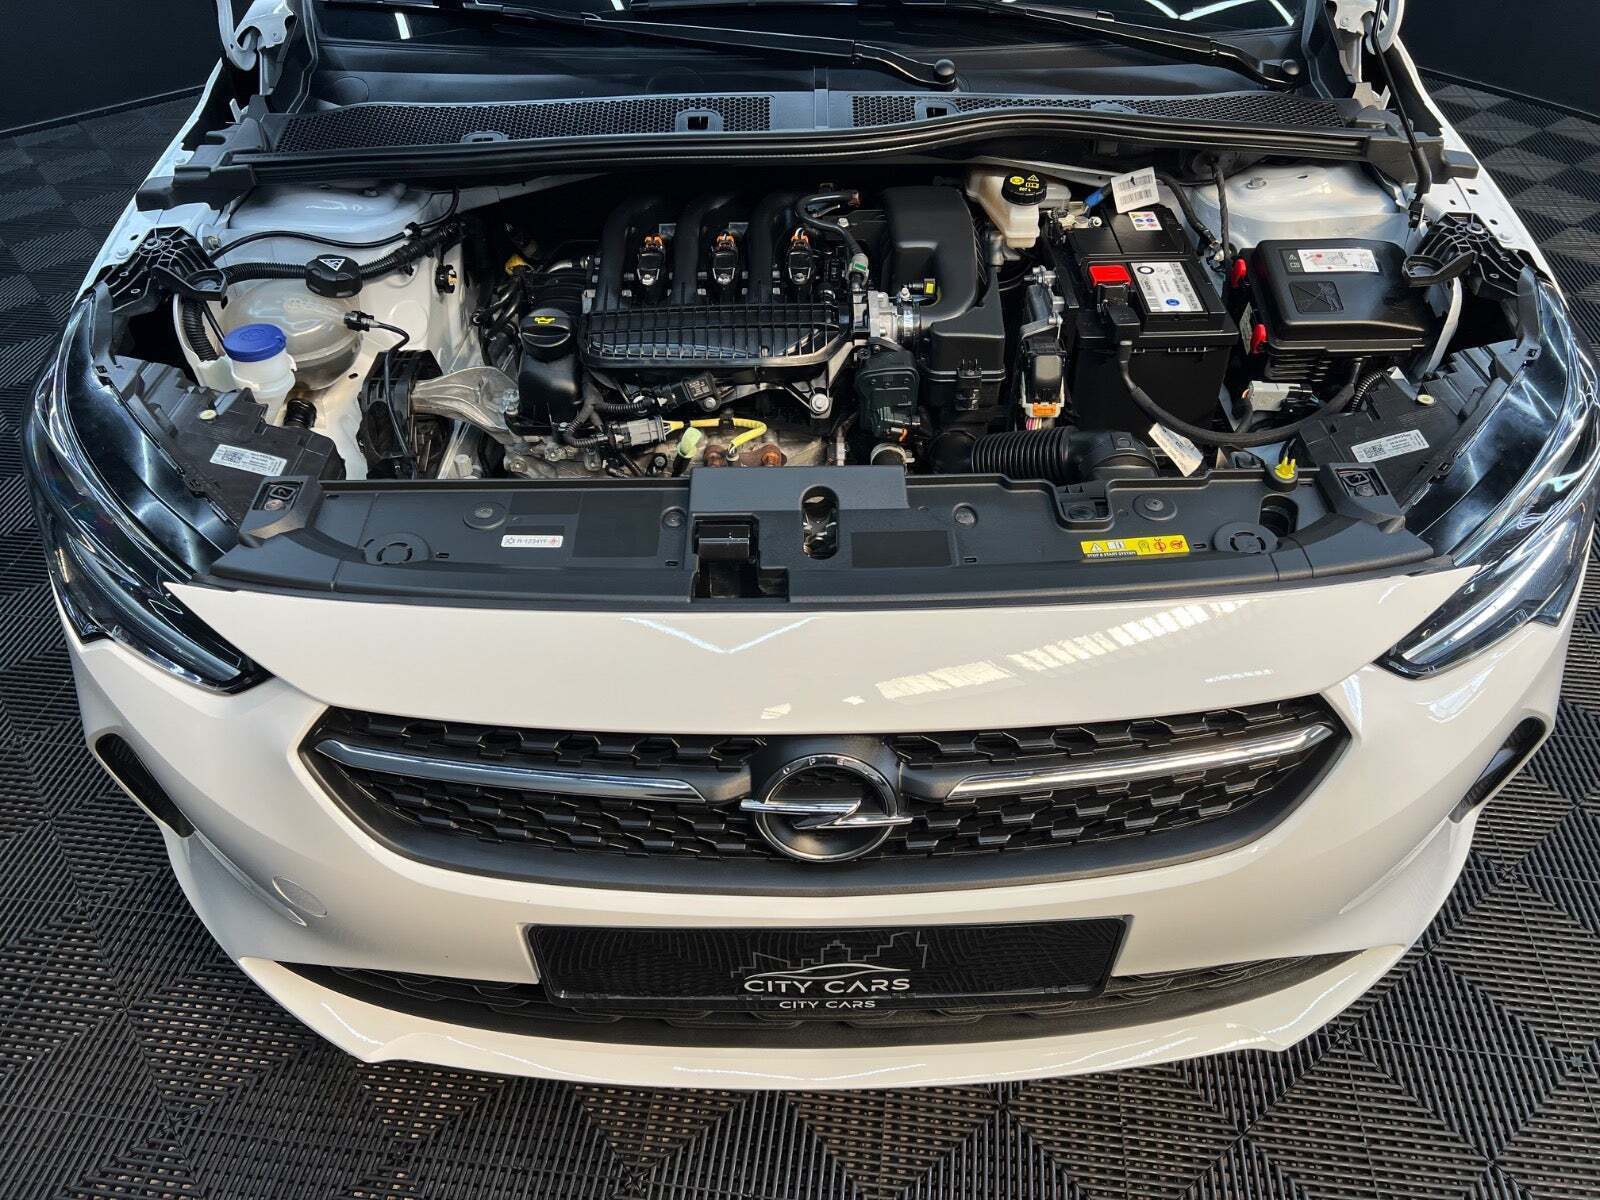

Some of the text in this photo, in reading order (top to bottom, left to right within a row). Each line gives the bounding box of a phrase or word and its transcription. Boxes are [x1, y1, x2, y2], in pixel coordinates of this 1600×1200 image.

[744, 978, 911, 994] CITY CARS
[779, 1000, 876, 1009] CITY CARS
